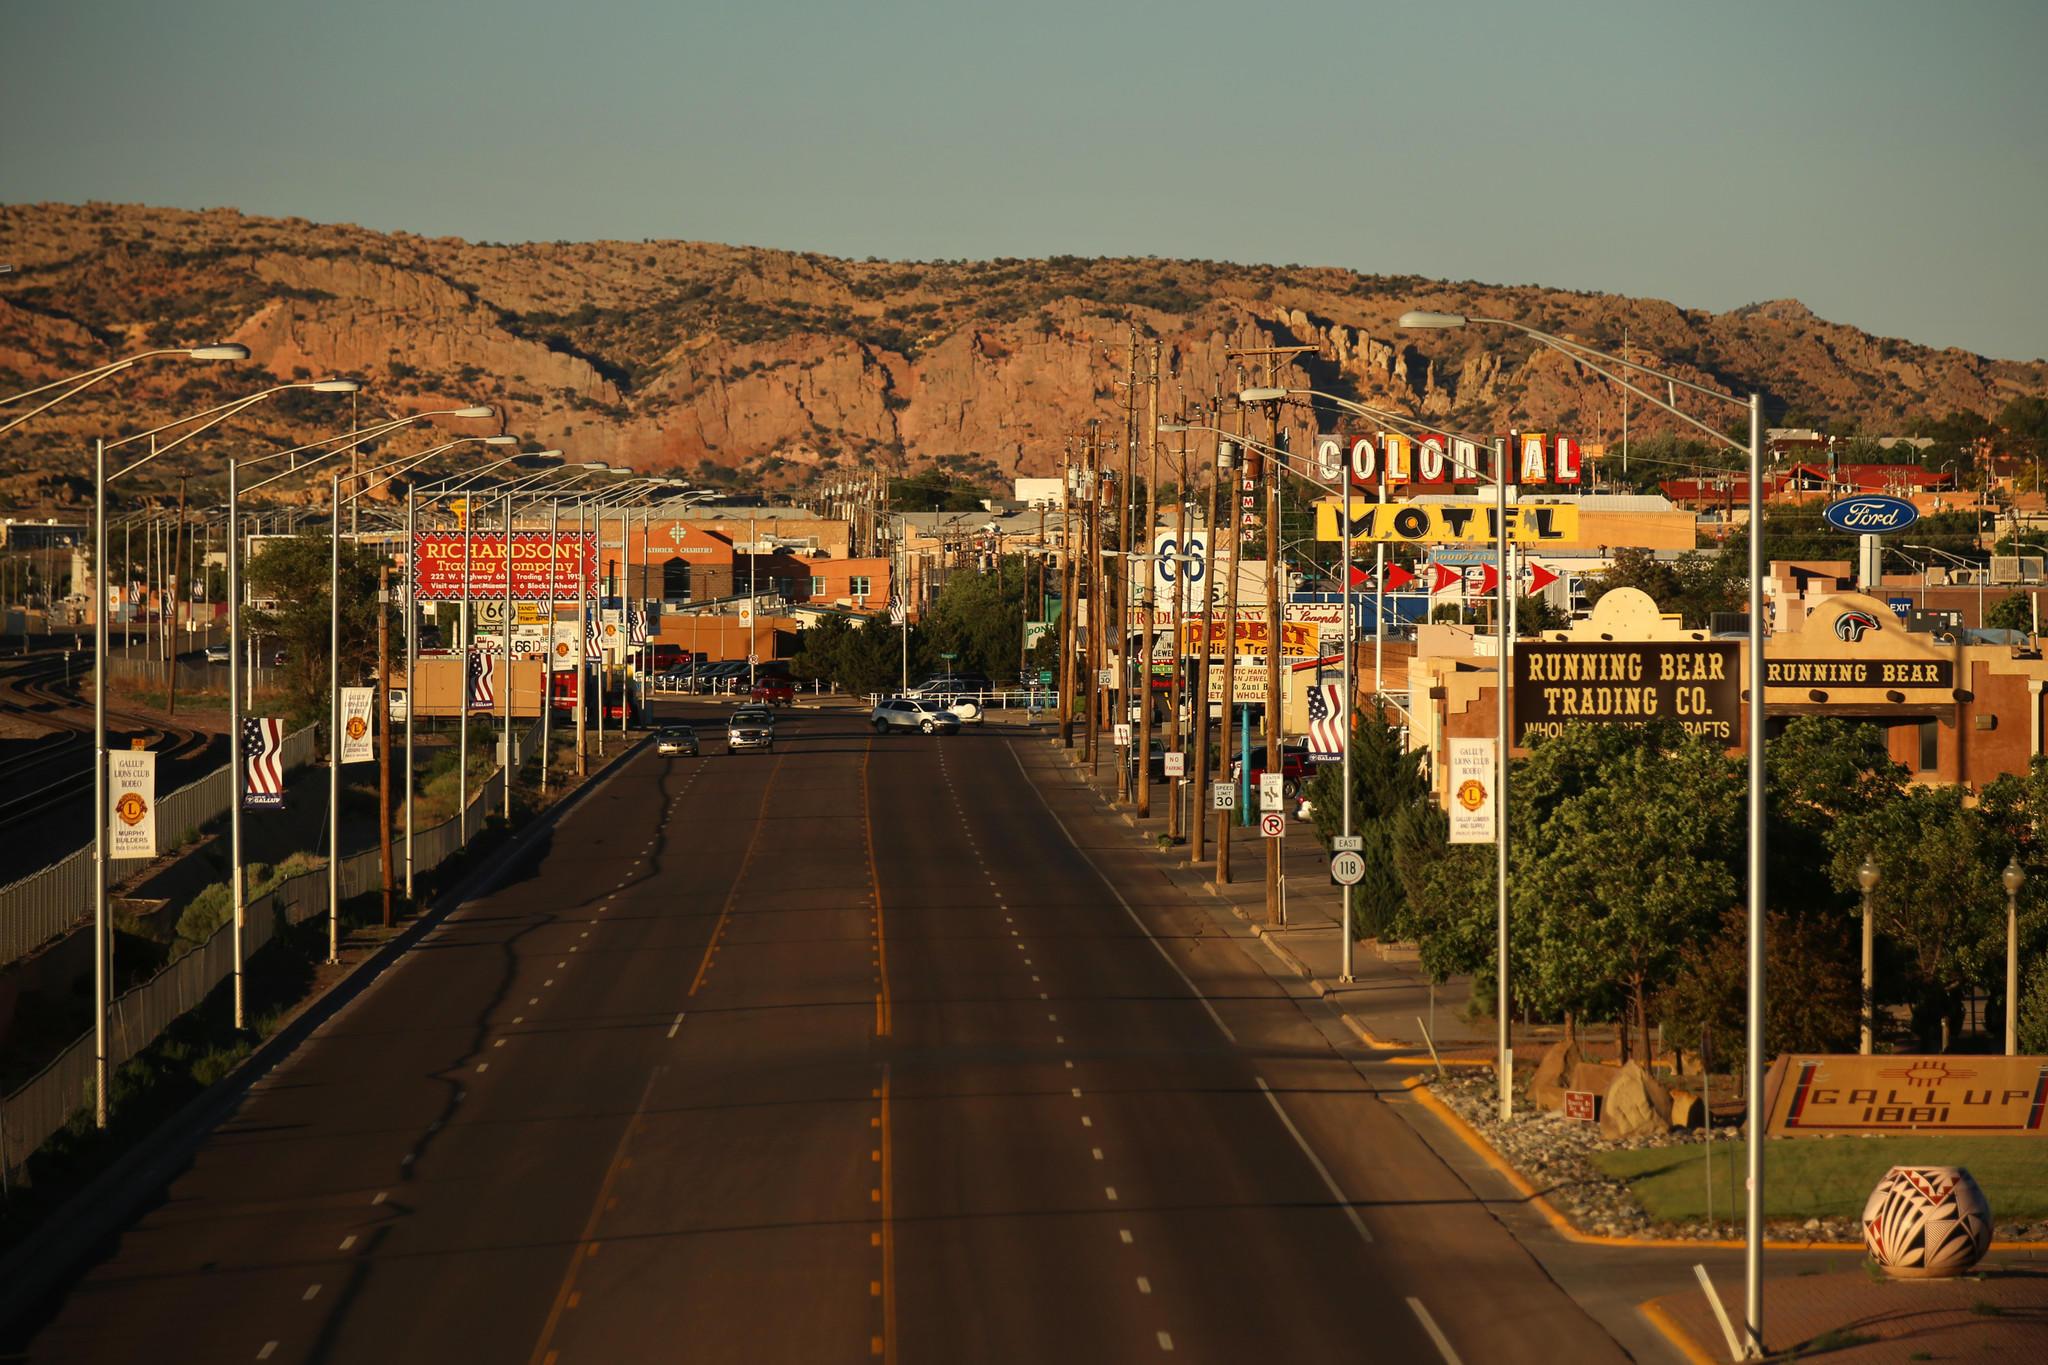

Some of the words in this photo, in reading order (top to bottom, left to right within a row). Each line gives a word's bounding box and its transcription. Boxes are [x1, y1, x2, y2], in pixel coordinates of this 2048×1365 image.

[1318, 439, 1578, 480] COLONAL
[1844, 503, 1898, 526] Ford
[1335, 507, 1564, 539] MOTEL
[426, 543, 586, 559] RICHARDSON'S
[501, 561, 574, 574] Company
[1160, 539, 1204, 582] 66
[461, 573, 492, 581] Hghway
[516, 573, 542, 581] Trading
[1890, 603, 1911, 612] EXIT
[515, 640, 531, 652] 66
[1245, 642, 1304, 656] Traers
[1528, 652, 1643, 681] RUNNING
[1659, 652, 1726, 681] BEAR
[1767, 663, 1868, 682] RUNNING
[1882, 663, 1940, 682] BEAR
[1236, 691, 1288, 699] WHOLEE
[1544, 687, 1658, 715] TRADING
[1675, 687, 1713, 715] CO.
[120, 760, 144, 768] GALLUP
[1462, 767, 1482, 775] RODEO
[114, 770, 132, 778] LIONS
[133, 770, 150, 778] CLUB
[121, 780, 142, 788] RODEO
[1216, 796, 1233, 807] 30
[1339, 839, 1357, 848] EAST
[1340, 861, 1357, 875] 118
[1810, 1089, 2031, 1105] GALLUP
[1862, 1106, 1951, 1122] 1881
